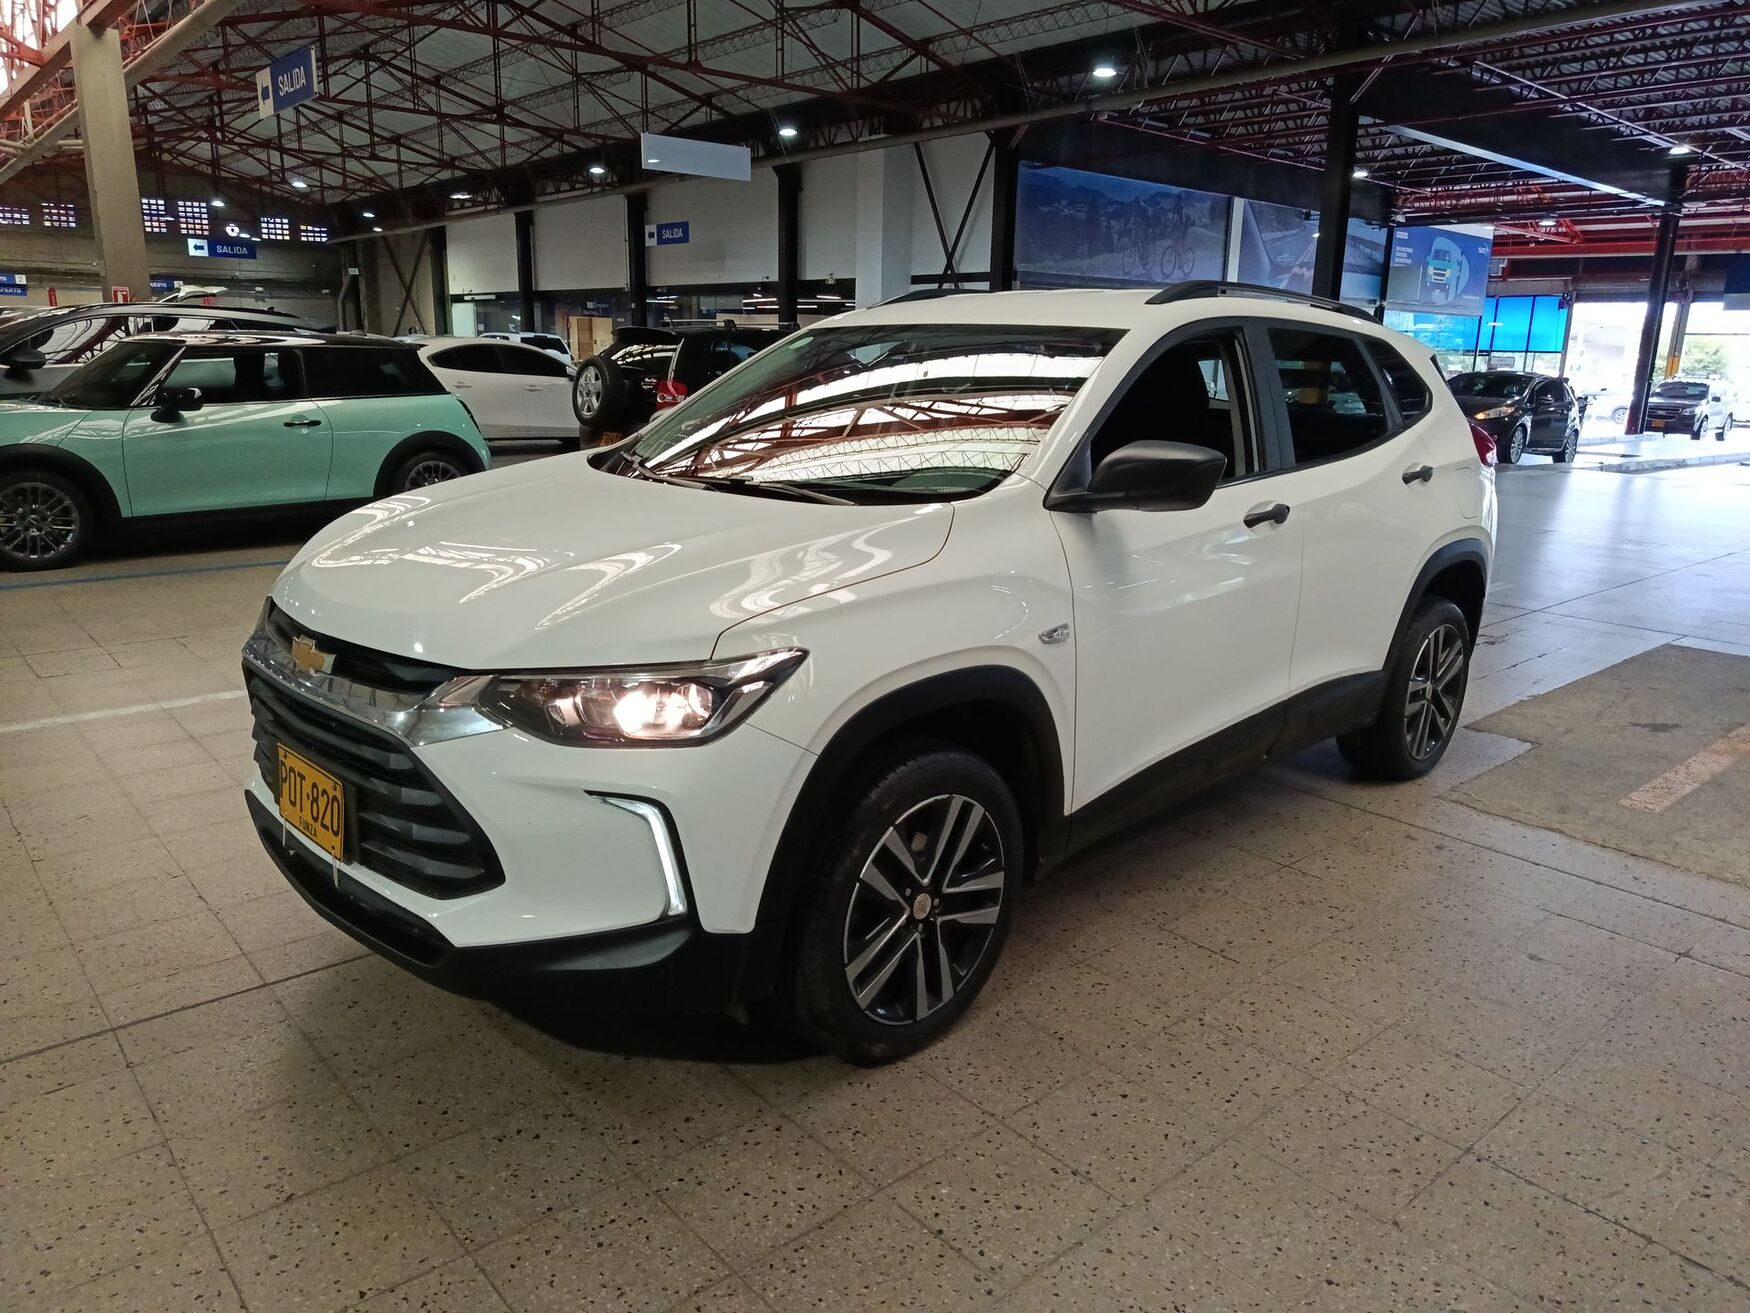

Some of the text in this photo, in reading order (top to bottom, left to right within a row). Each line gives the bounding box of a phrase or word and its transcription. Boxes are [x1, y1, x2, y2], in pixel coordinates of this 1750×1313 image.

[278, 65, 306, 96] SALIDA
[662, 228, 683, 239] SALIDA
[216, 245, 248, 255] SALIDA
